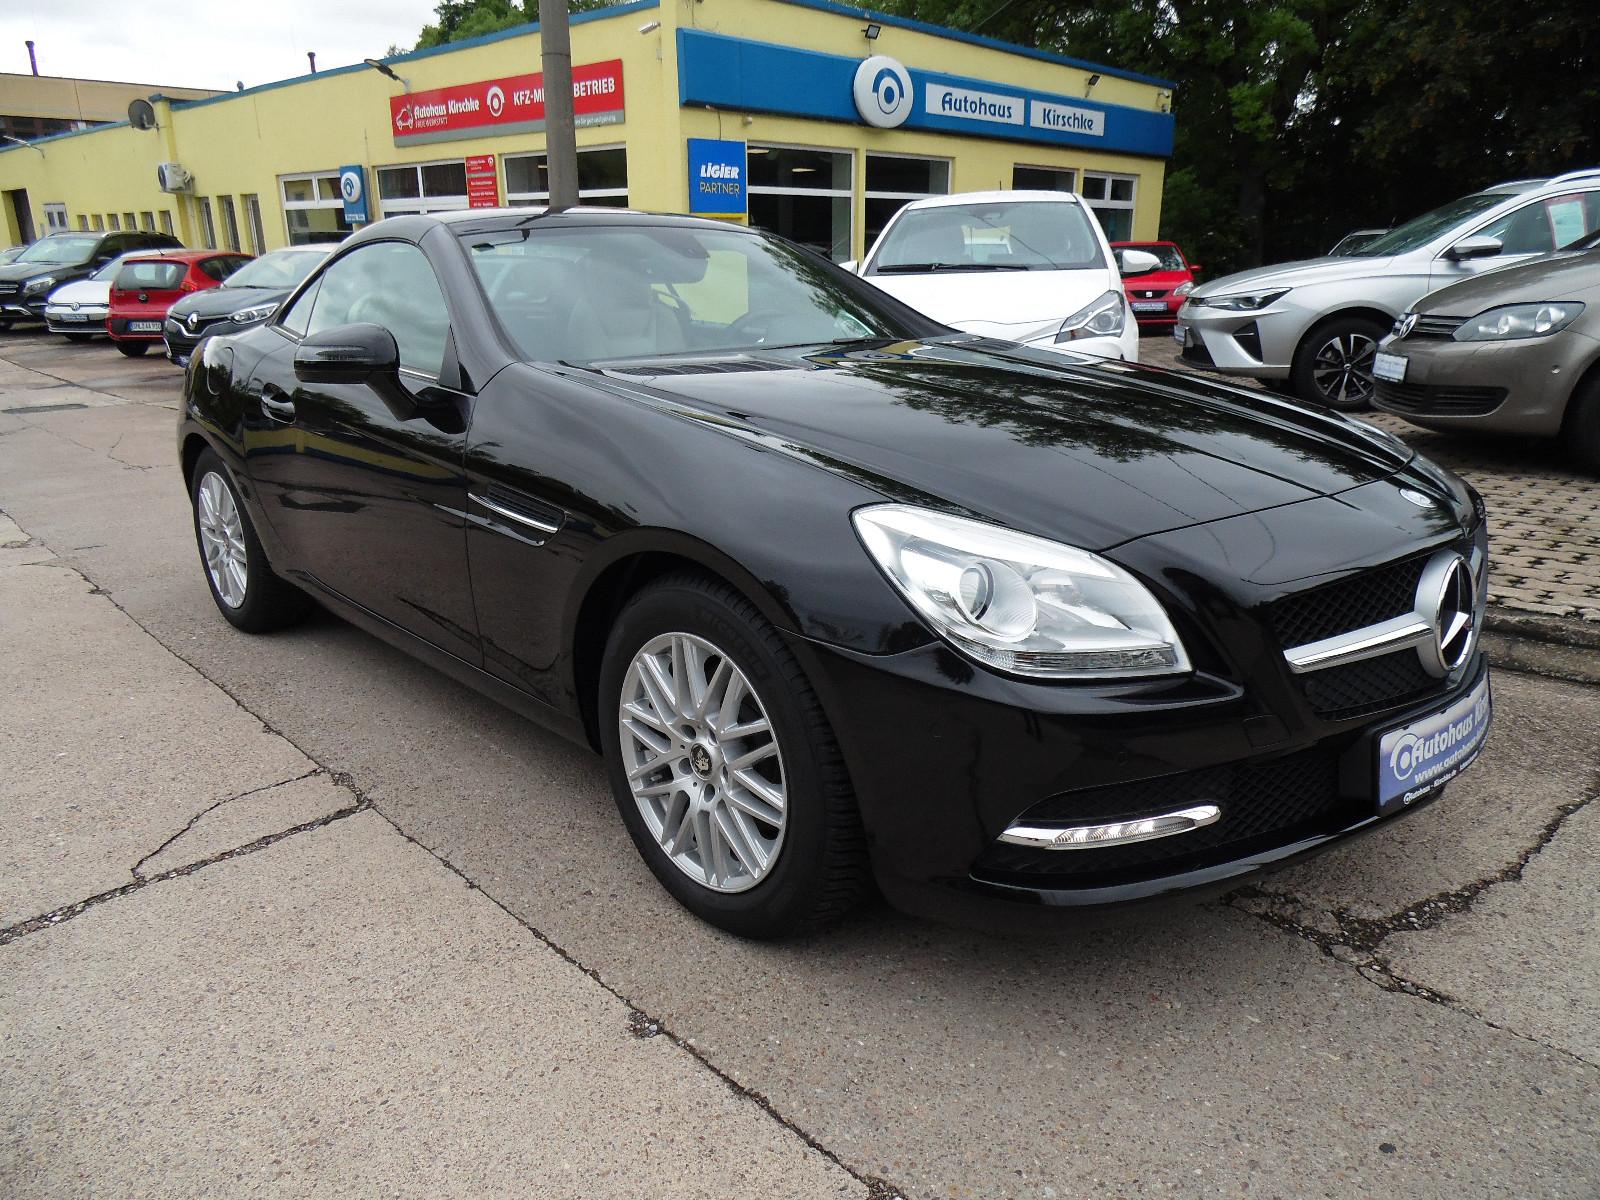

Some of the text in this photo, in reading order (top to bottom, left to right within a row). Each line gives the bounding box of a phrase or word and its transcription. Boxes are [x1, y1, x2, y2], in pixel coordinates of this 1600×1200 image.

[414, 97, 480, 120] Autohaus Kirschke
[942, 92, 1094, 131] Autohaus Kirschke
[700, 182, 740, 195] PARTNER
[1412, 714, 1473, 768] Autohaus
